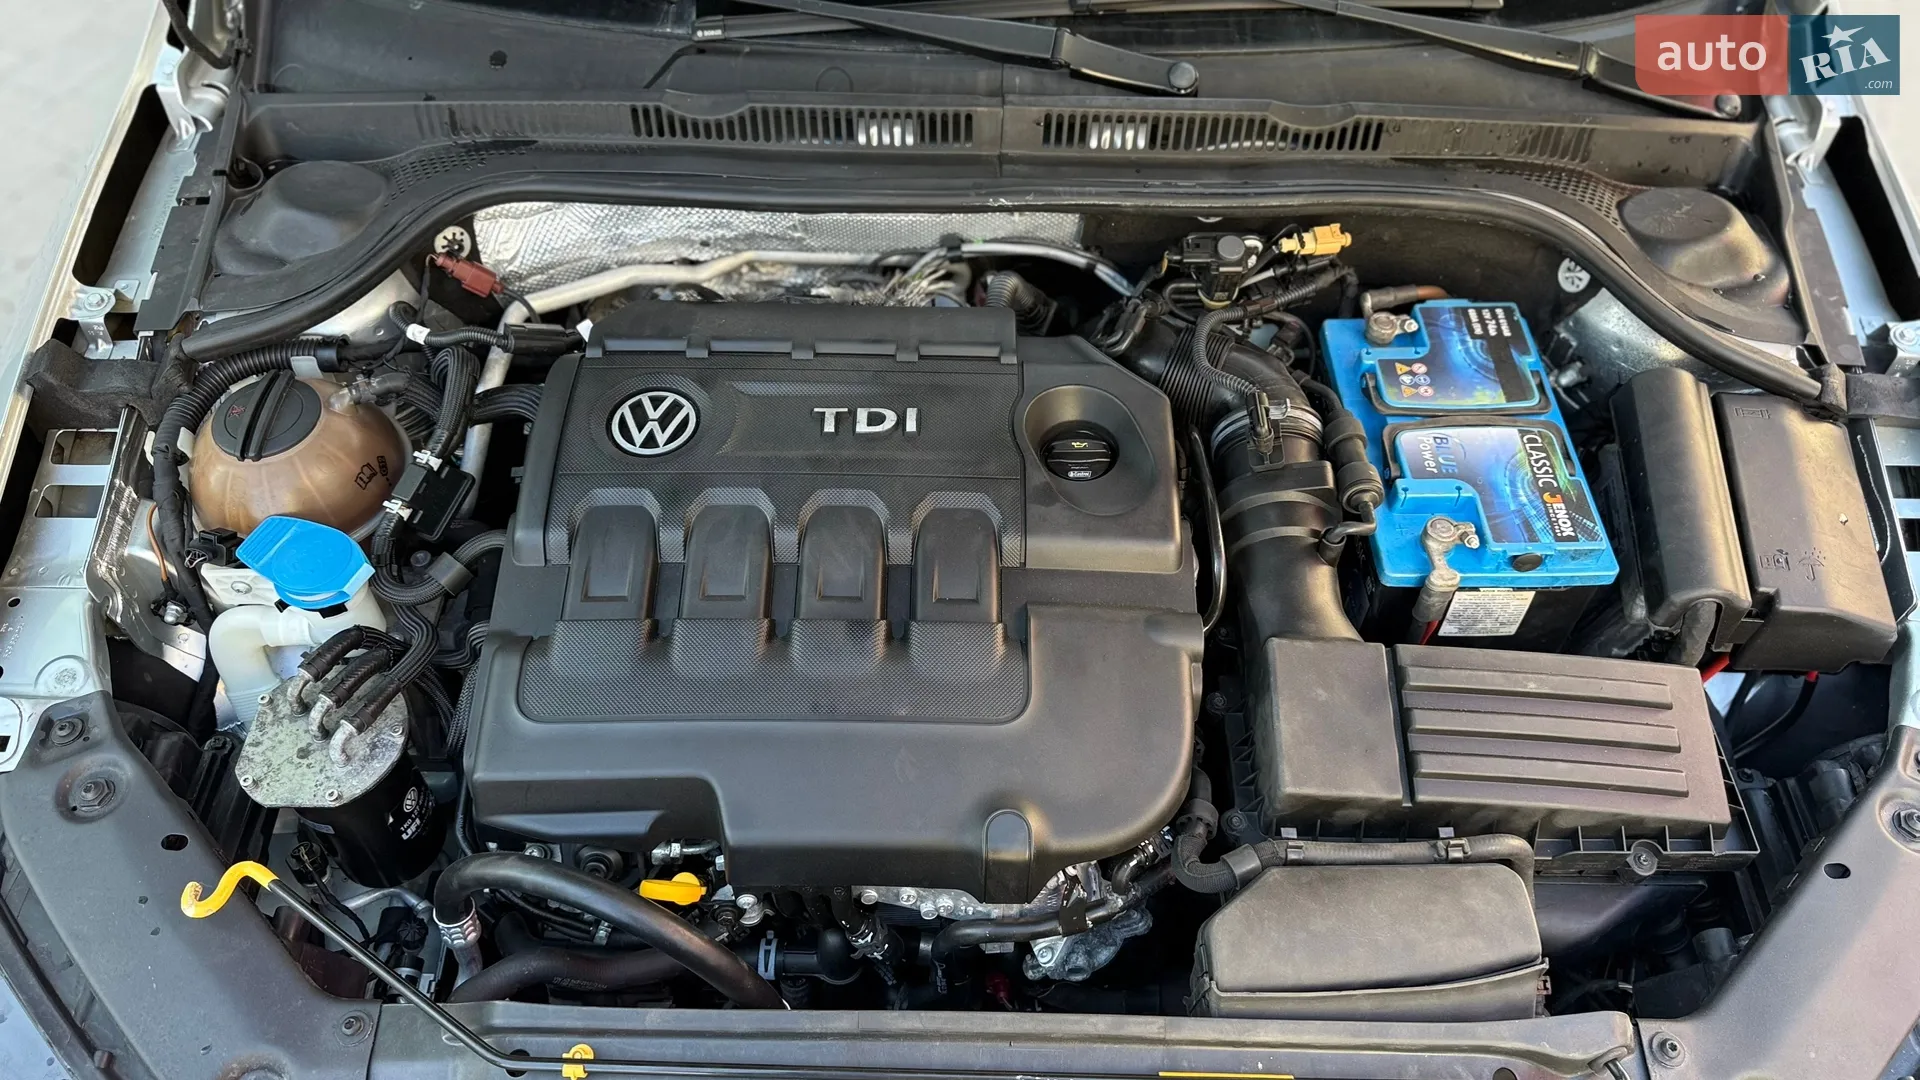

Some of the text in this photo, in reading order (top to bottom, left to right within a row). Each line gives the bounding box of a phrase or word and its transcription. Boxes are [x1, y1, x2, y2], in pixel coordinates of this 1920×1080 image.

[813, 407, 919, 434] TDI
[1432, 436, 1458, 473] BLUE
[1522, 434, 1558, 488] CLASSIC
[1542, 492, 1576, 537] JENOX
[401, 817, 421, 840] UFI
